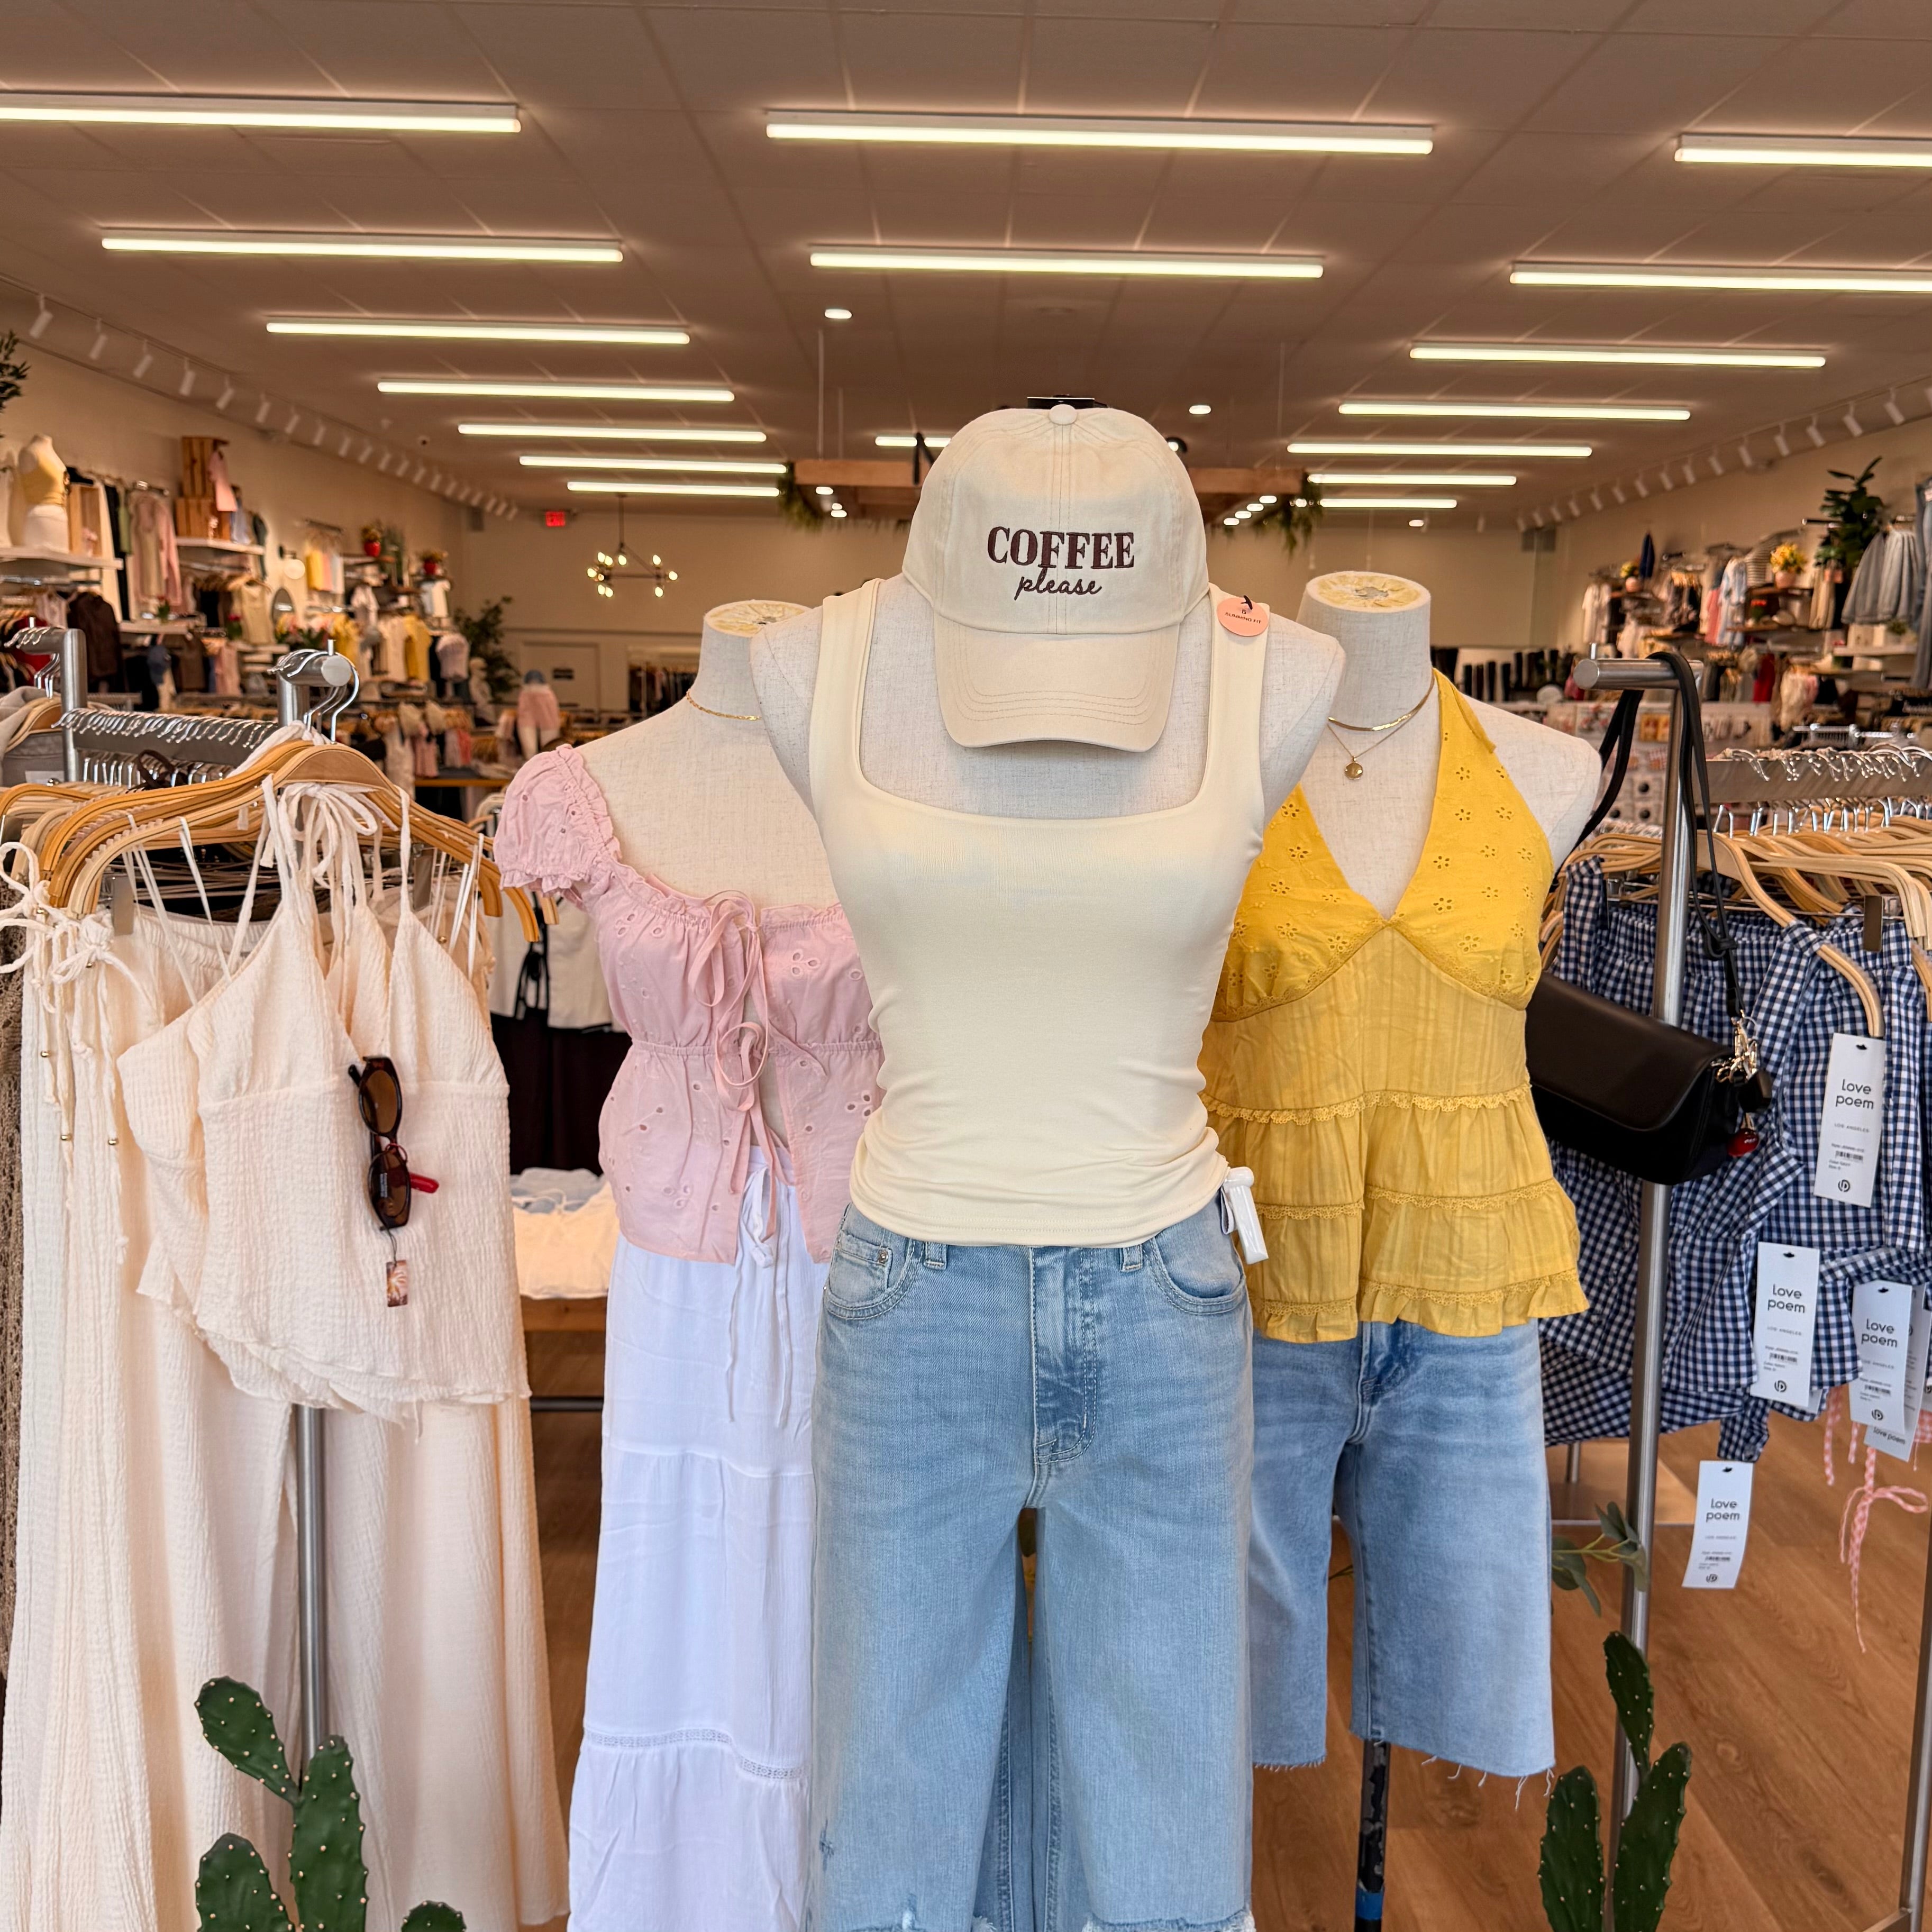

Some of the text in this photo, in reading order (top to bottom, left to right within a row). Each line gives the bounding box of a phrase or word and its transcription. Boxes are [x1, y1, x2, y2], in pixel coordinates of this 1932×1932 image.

[987, 526, 1135, 569] COFFEE
[1014, 568, 1102, 601] please
[1835, 1095, 1874, 1109] poem
[1767, 1299, 1805, 1314] poem
[1861, 1333, 1898, 1348] poem
[1706, 1512, 1740, 1523] poem
